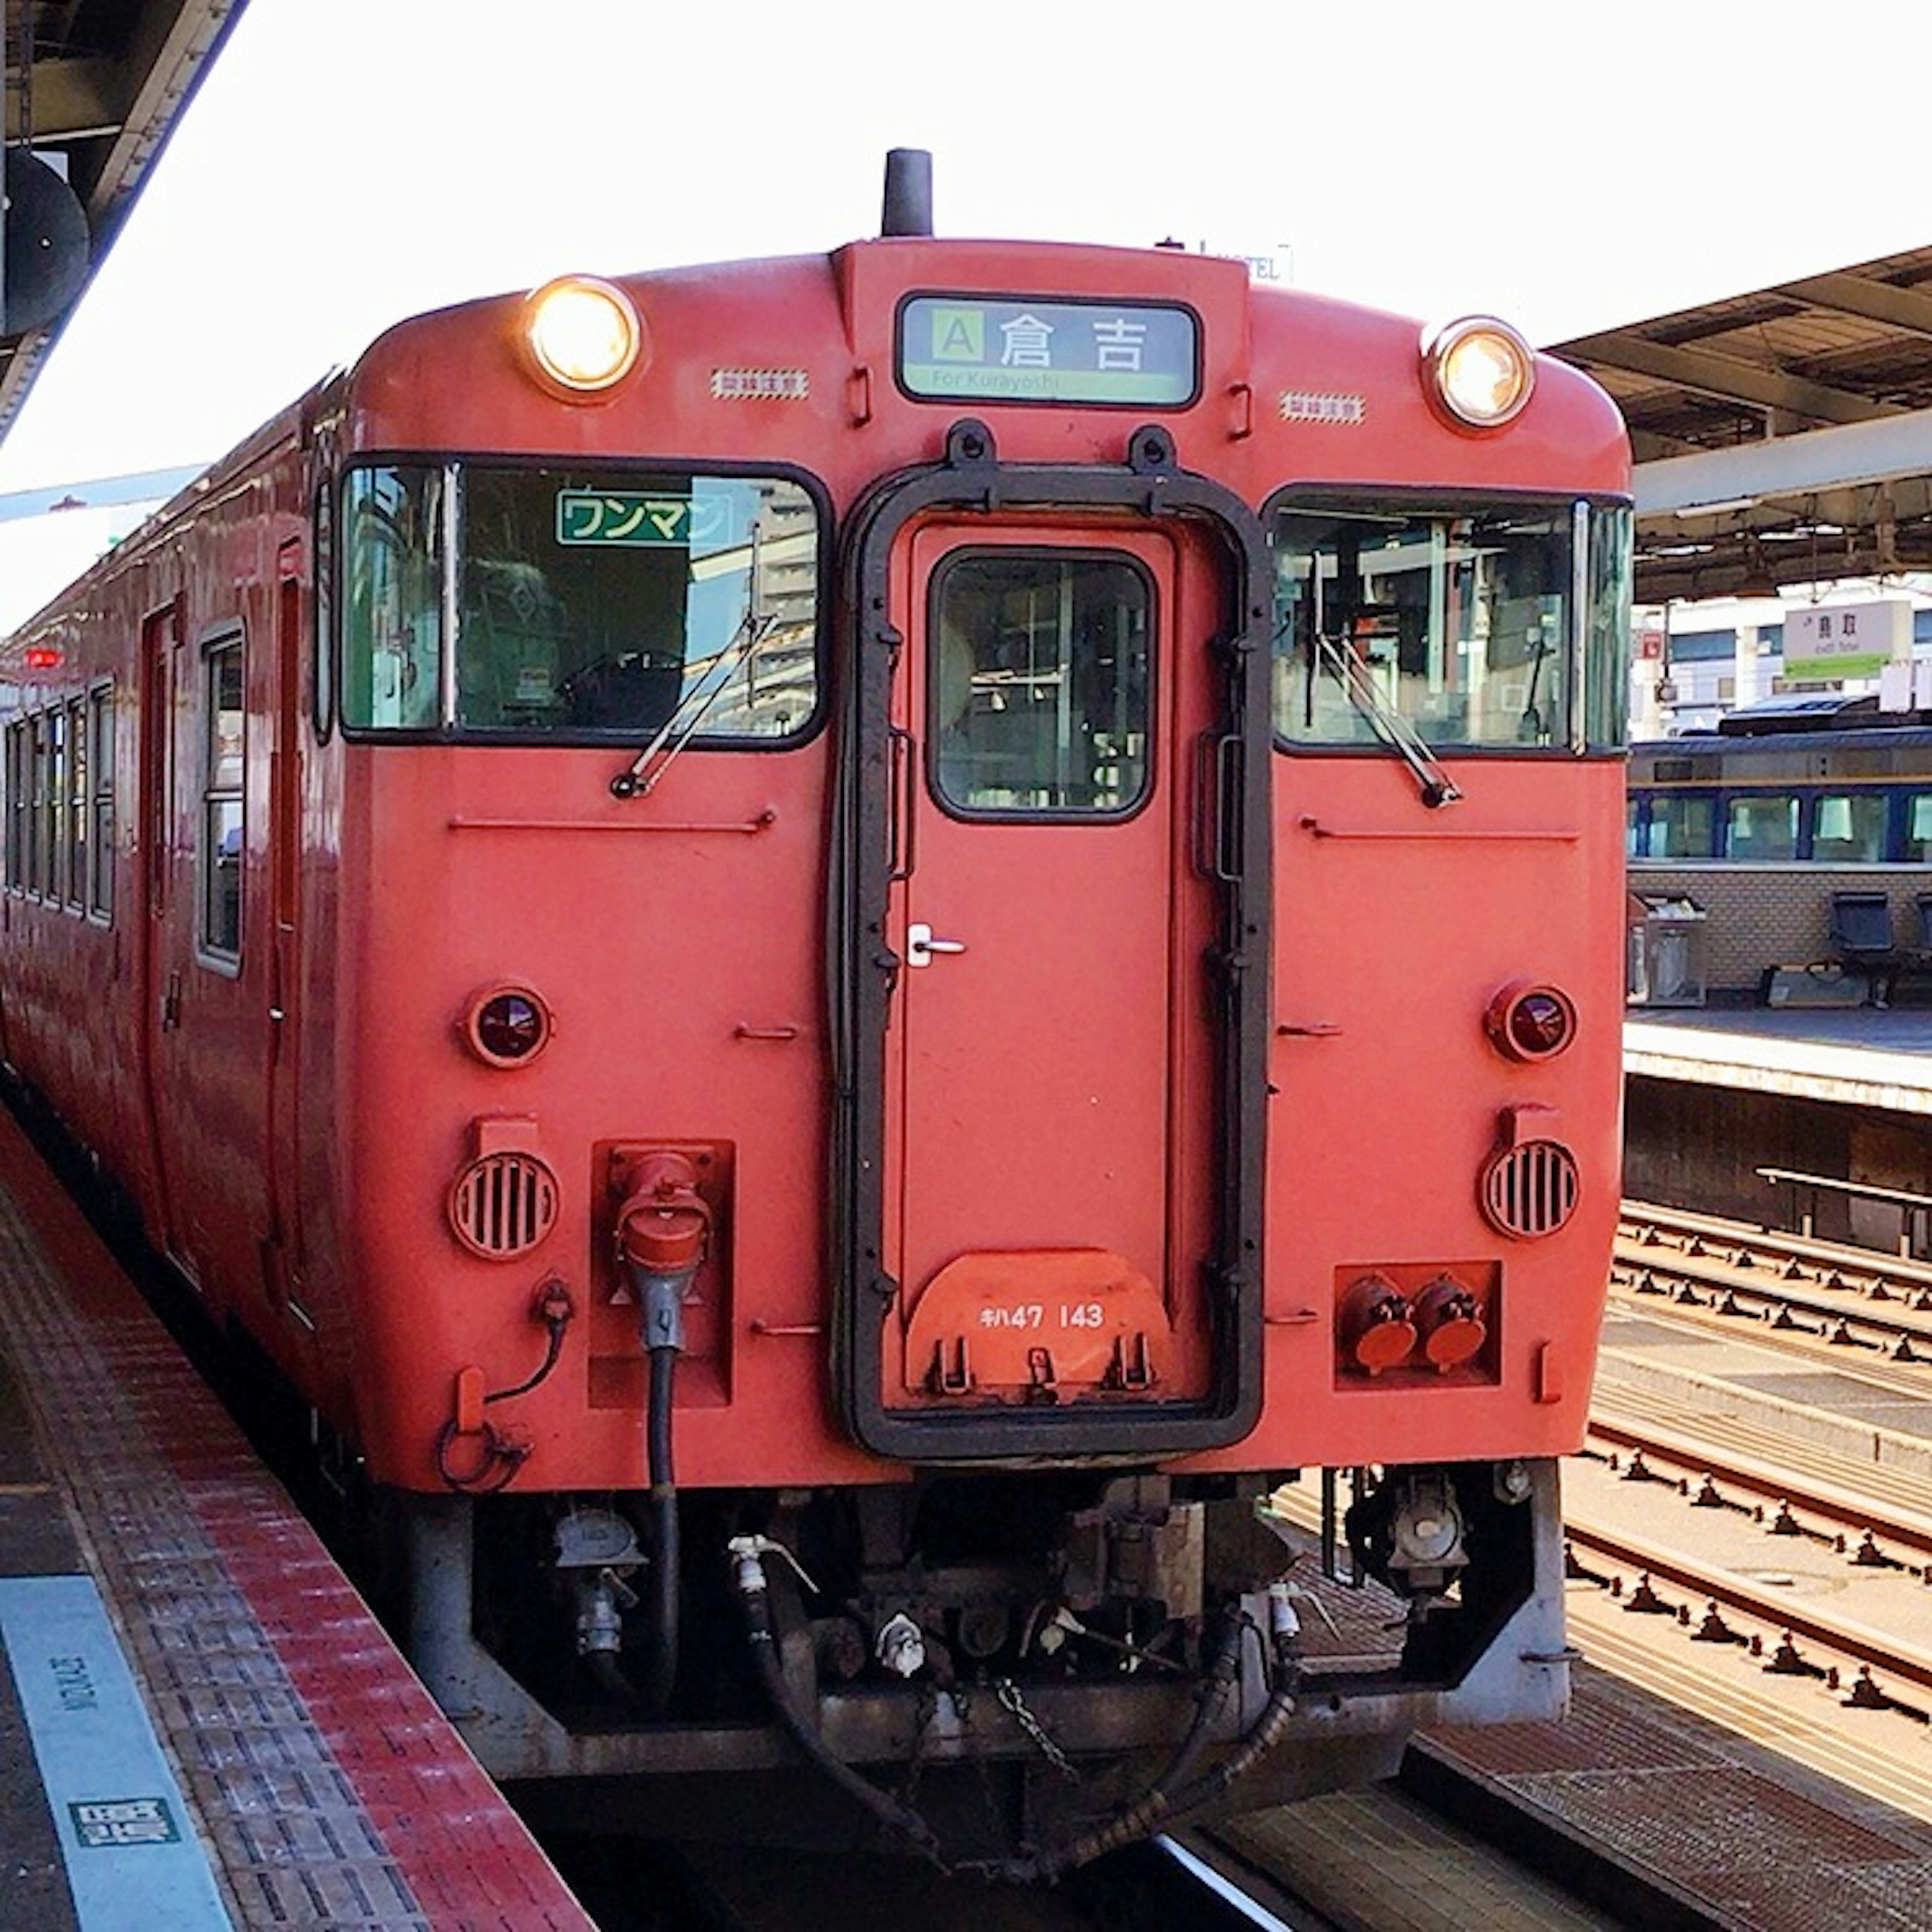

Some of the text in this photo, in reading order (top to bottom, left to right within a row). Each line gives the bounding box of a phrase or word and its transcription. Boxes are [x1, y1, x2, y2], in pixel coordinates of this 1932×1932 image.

[942, 317, 974, 353] A
[999, 313, 1148, 371] 倉吉
[932, 370, 1060, 391] For Kurayoshi
[565, 498, 726, 540] ワンマン
[1060, 1304, 1103, 1328] 143
